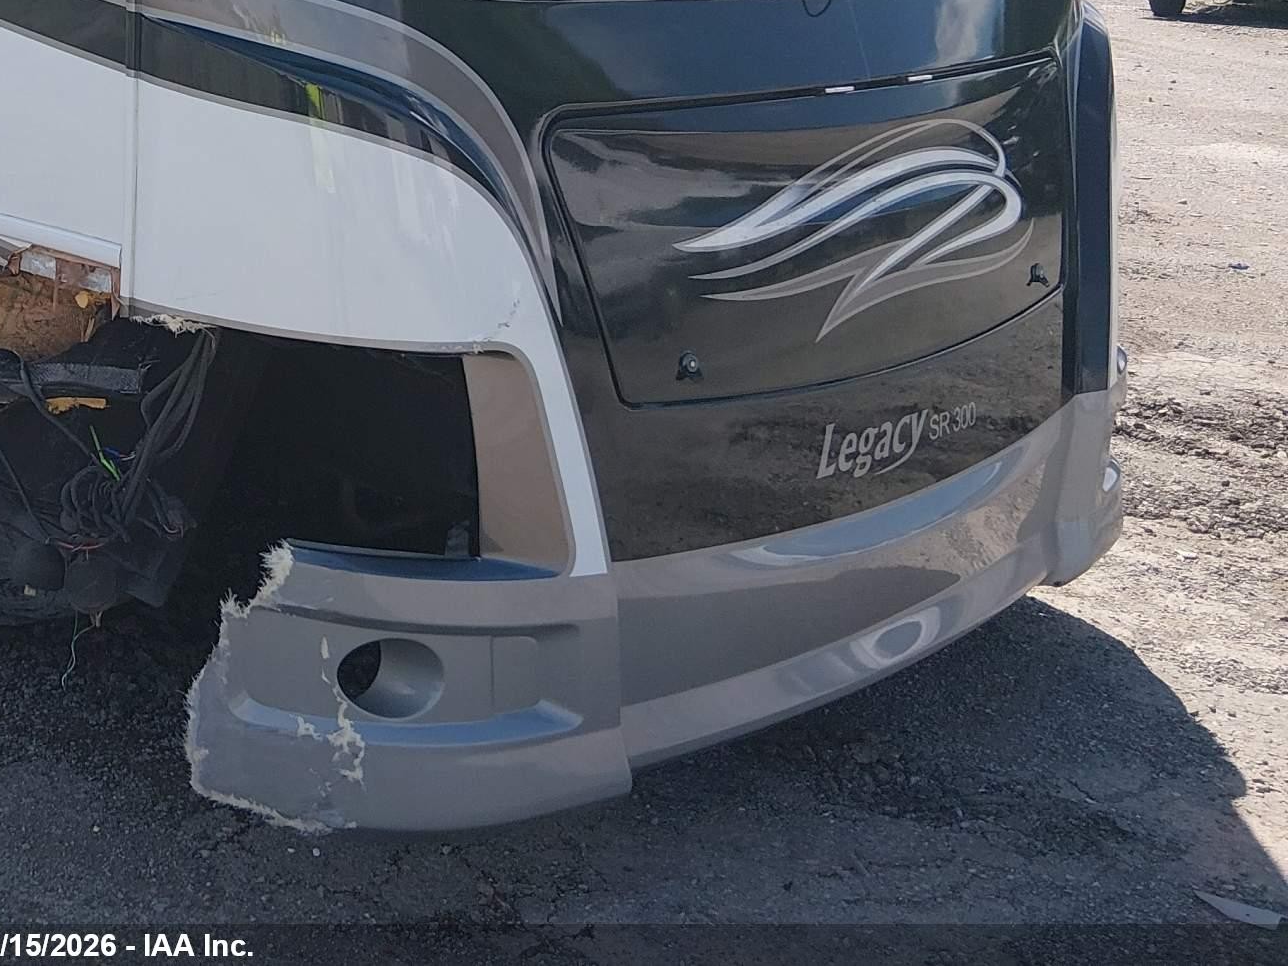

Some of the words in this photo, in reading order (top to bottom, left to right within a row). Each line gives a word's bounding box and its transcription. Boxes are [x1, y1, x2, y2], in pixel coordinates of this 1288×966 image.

[816, 409, 929, 479] Legacy
[929, 411, 950, 440] SR
[952, 402, 977, 432] 300
